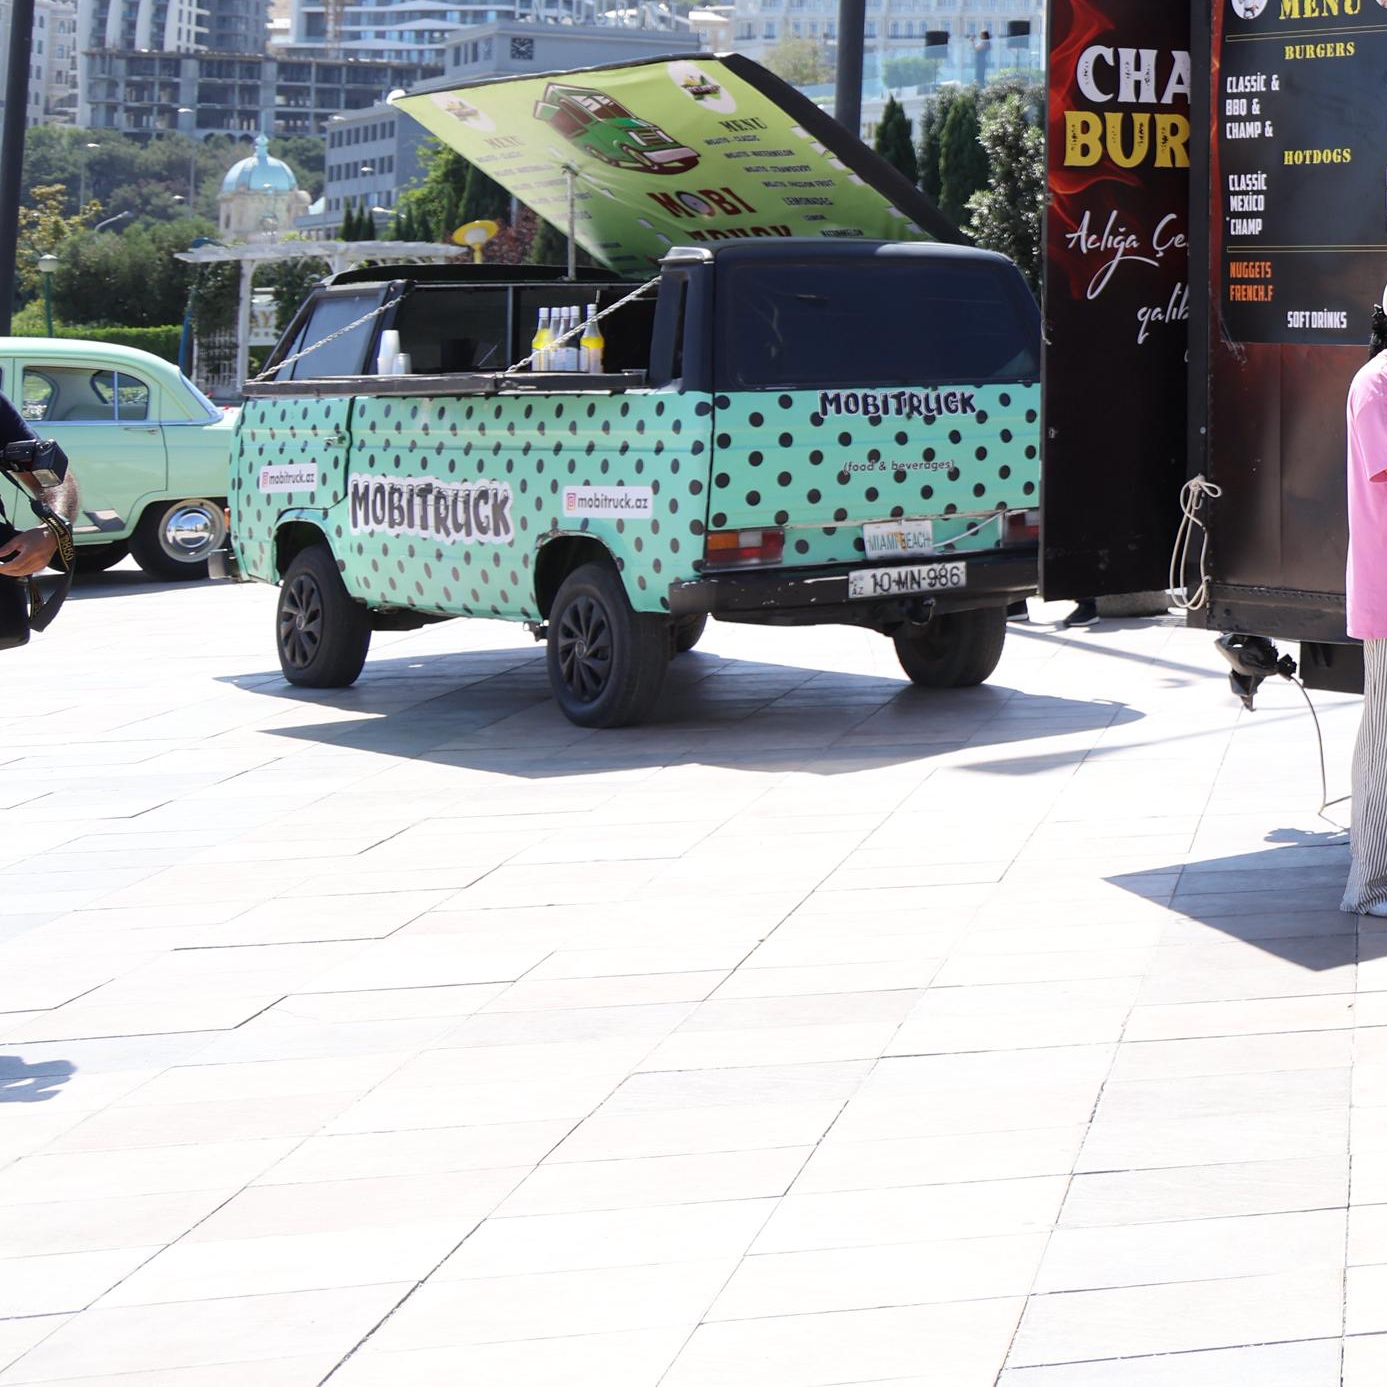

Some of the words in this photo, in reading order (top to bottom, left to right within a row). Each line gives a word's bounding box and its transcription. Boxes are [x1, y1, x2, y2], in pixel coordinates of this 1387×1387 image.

[1285, 42, 1355, 59] BURGERS
[1226, 99, 1247, 116] BBQ
[719, 117, 767, 132] MENU
[1226, 121, 1262, 139] CHAMP
[1284, 149, 1351, 165] HOTDOGS
[646, 187, 758, 219] MOBI
[1230, 218, 1263, 235] CHAMP
[1230, 262, 1272, 278] NUGGETS
[1287, 311, 1311, 328] SOFT
[819, 391, 977, 417] MOBITRUCK
[268, 471, 315, 487] mobitruck.az
[351, 480, 510, 538] MOBITRUCK
[577, 493, 649, 510] mobitruck.az
